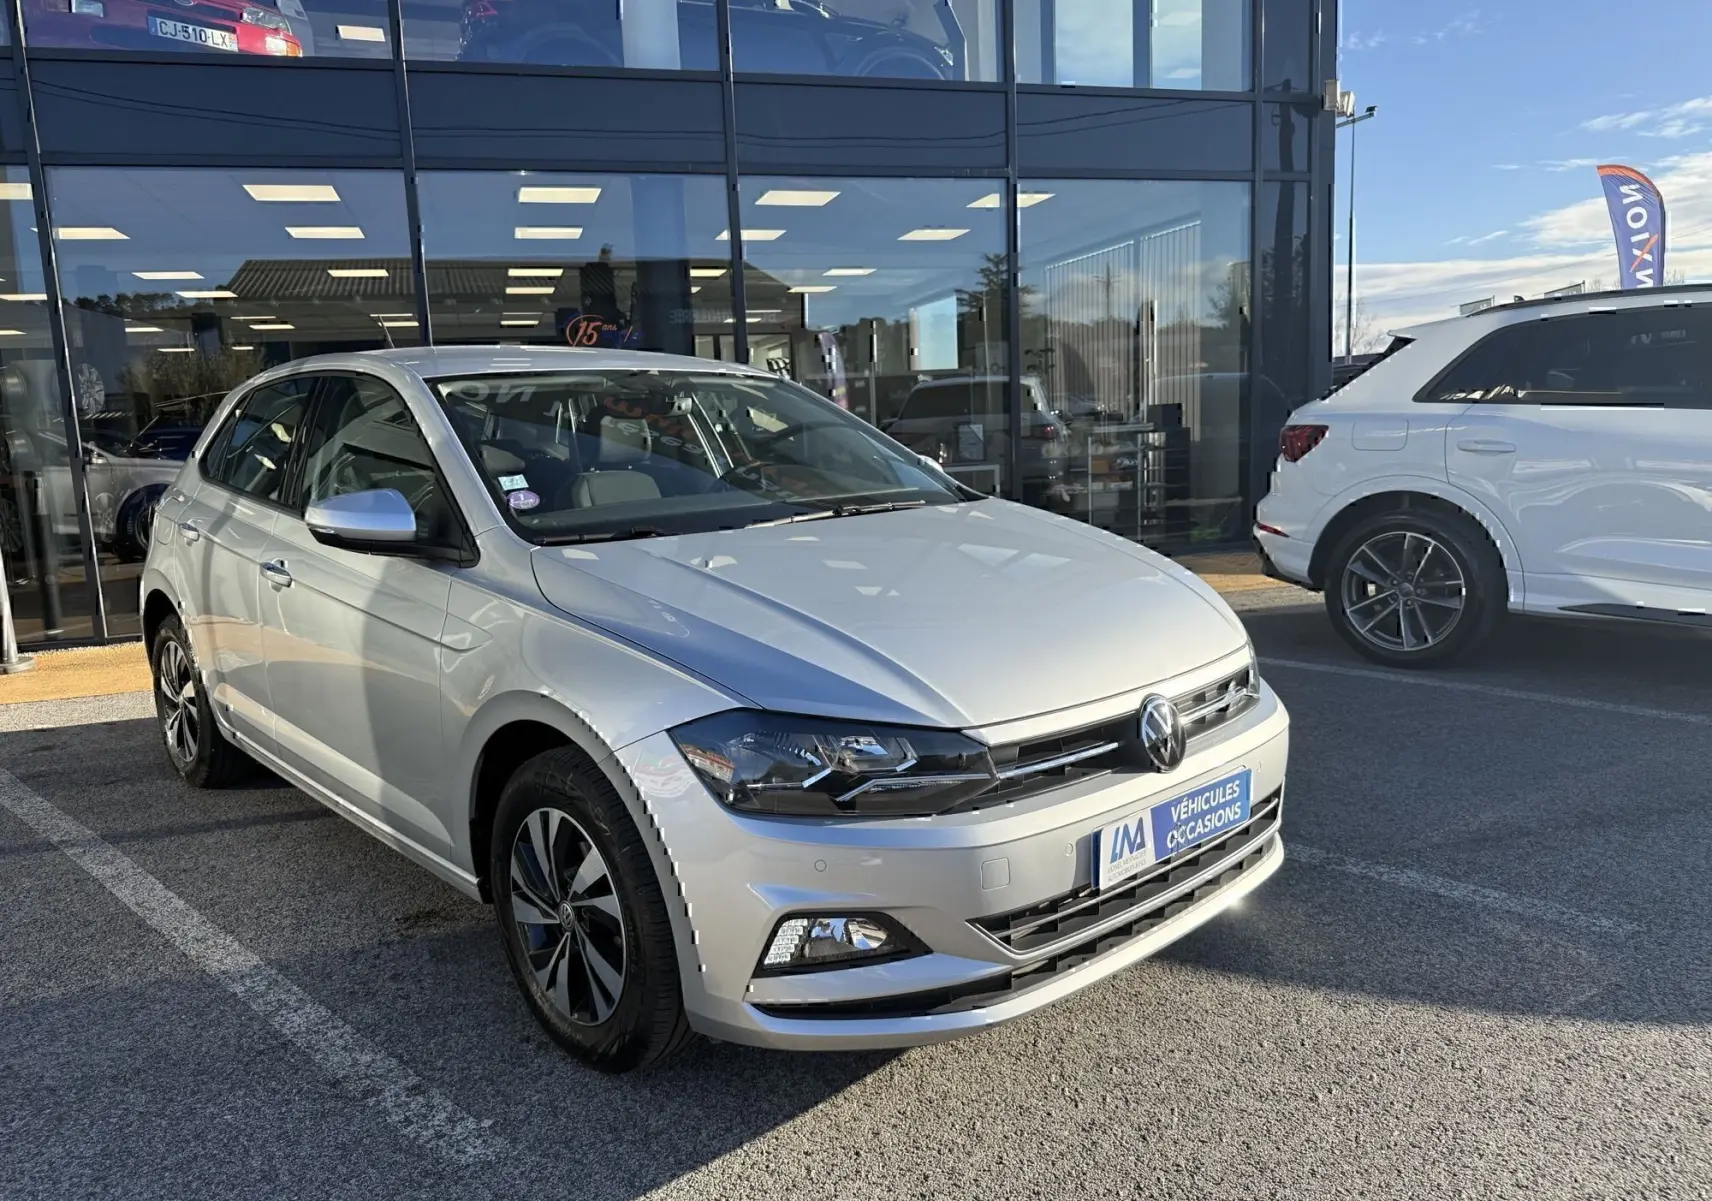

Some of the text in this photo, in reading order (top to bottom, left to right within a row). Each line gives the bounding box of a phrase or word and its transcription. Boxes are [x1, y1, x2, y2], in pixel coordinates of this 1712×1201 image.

[159, 22, 228, 47] CJ-510-LX
[573, 321, 602, 347] 15
[1171, 780, 1240, 823] VÉHICULES
[1166, 802, 1241, 848] OCCASIONS
